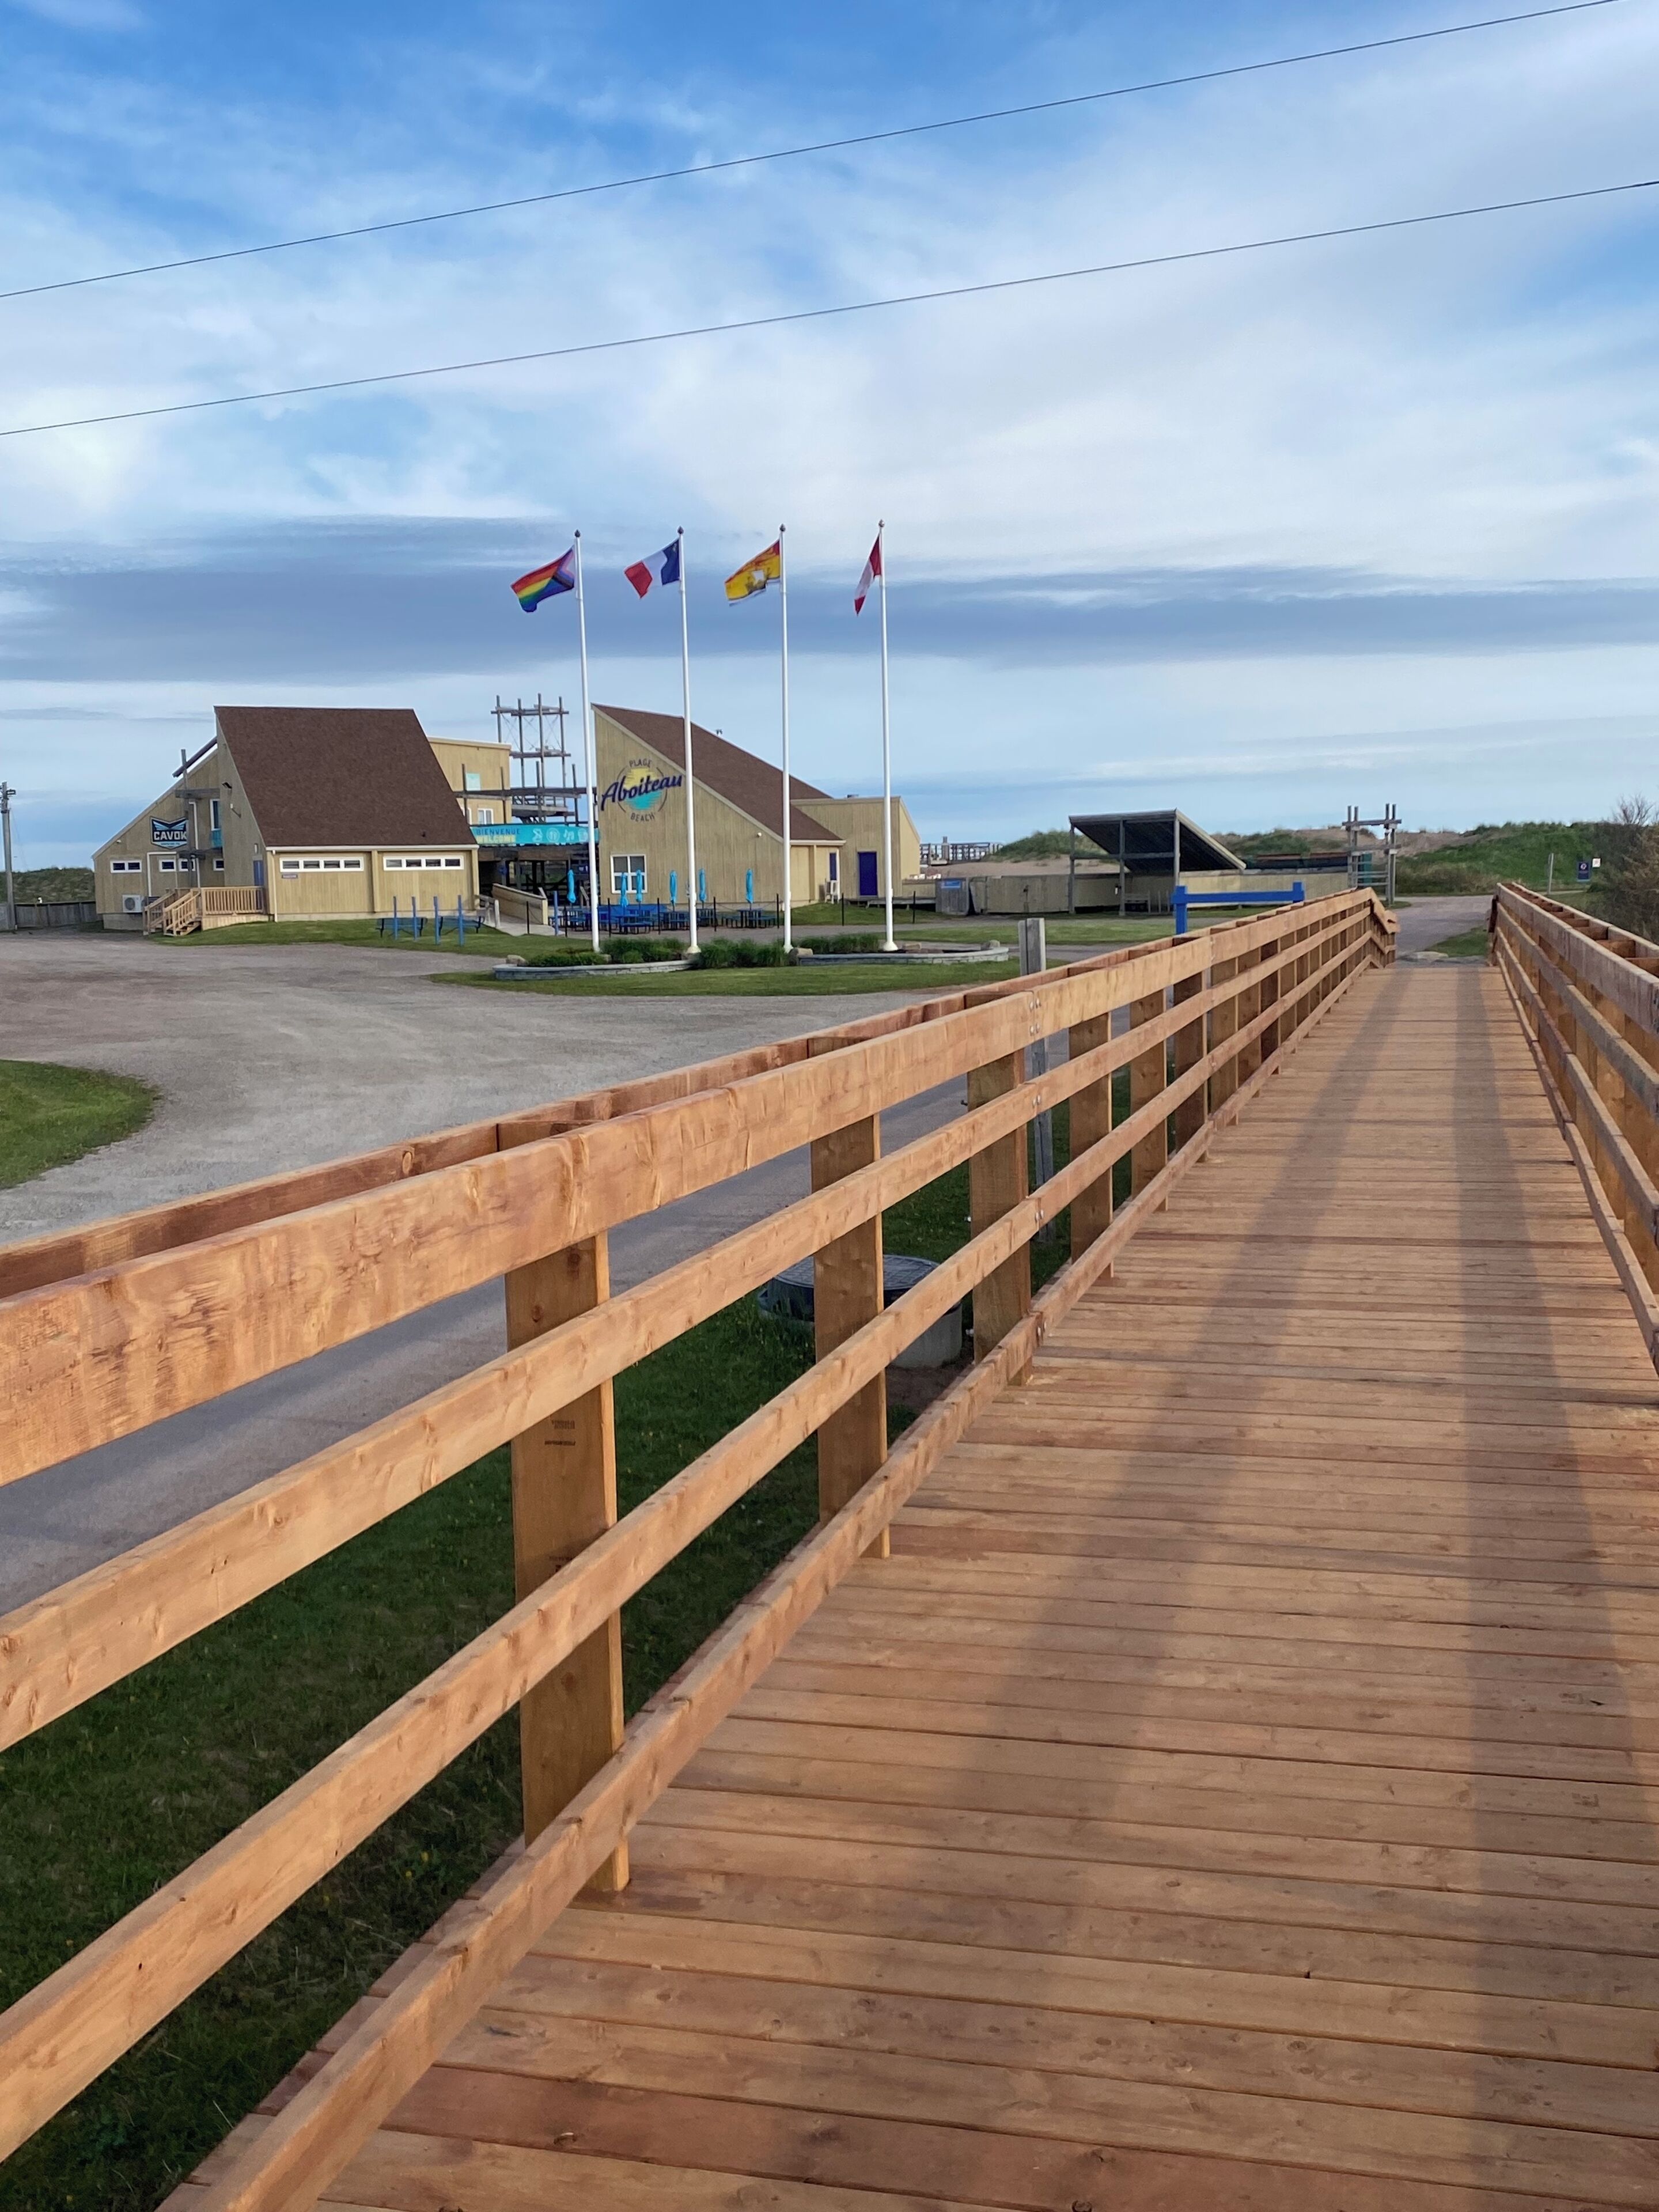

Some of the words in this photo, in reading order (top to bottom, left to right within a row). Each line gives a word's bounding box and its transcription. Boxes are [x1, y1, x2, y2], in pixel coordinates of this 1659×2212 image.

[601, 775, 682, 810] Aboiteau
[630, 812, 655, 822] BEACH
[153, 831, 188, 840] CAVOK
